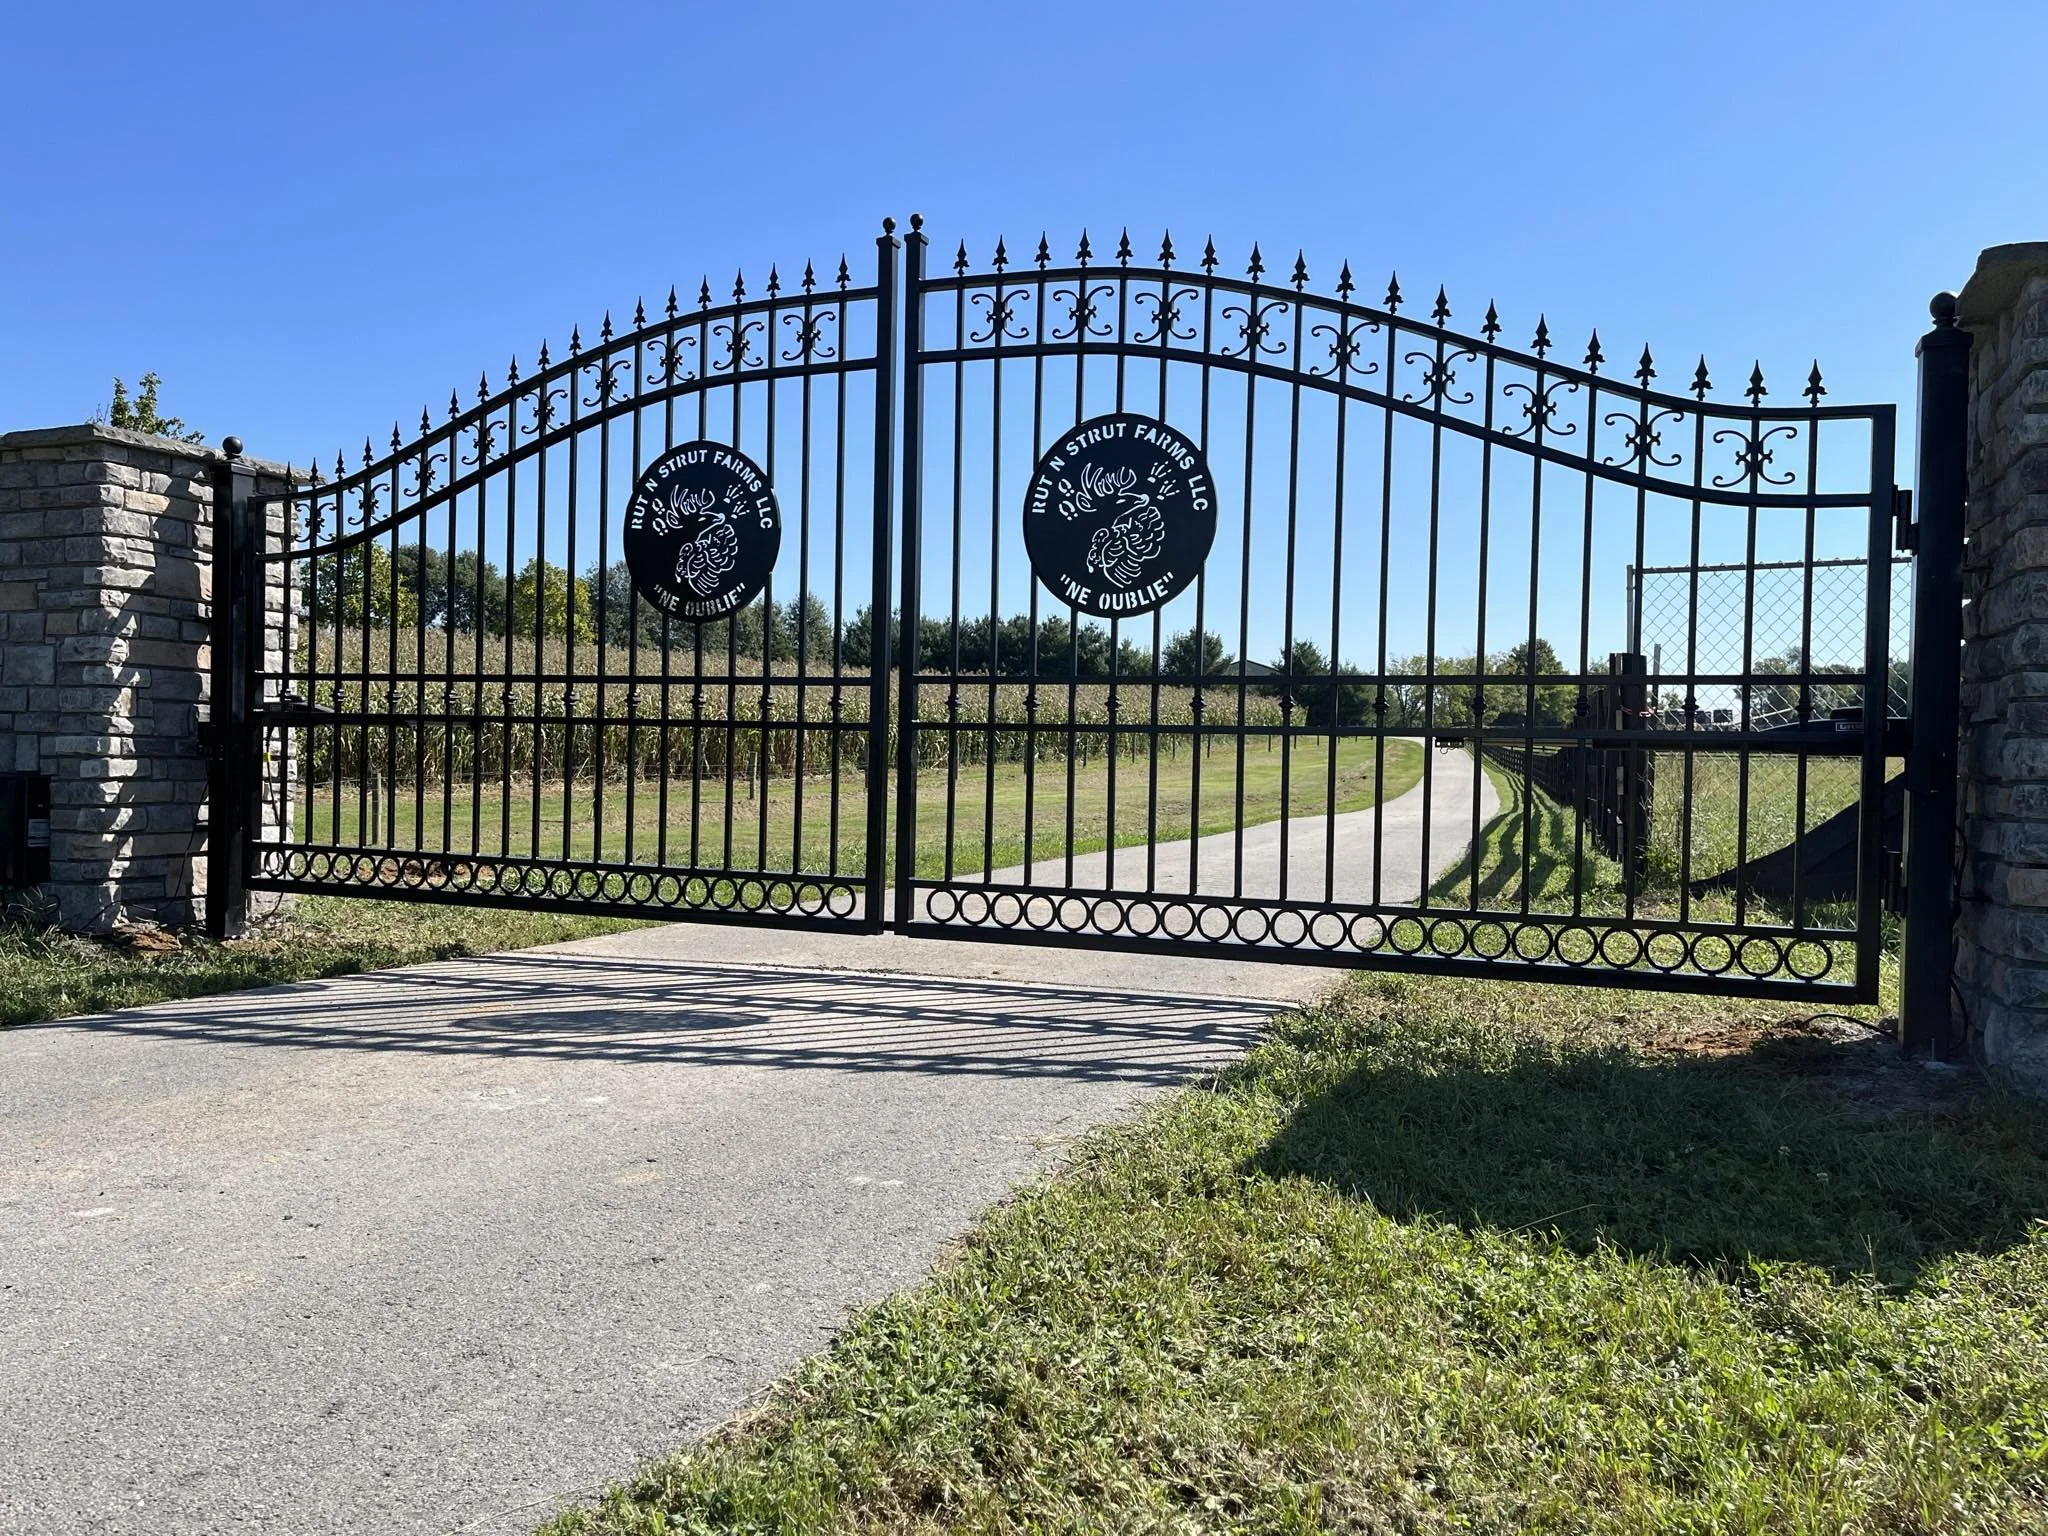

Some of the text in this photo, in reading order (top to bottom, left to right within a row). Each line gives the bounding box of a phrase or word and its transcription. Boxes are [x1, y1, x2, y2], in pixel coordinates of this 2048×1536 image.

[631, 449, 773, 529] RUT N STRUT FARMS LLC
[1031, 423, 1209, 513] RUT N STRUT FARMS LLC
